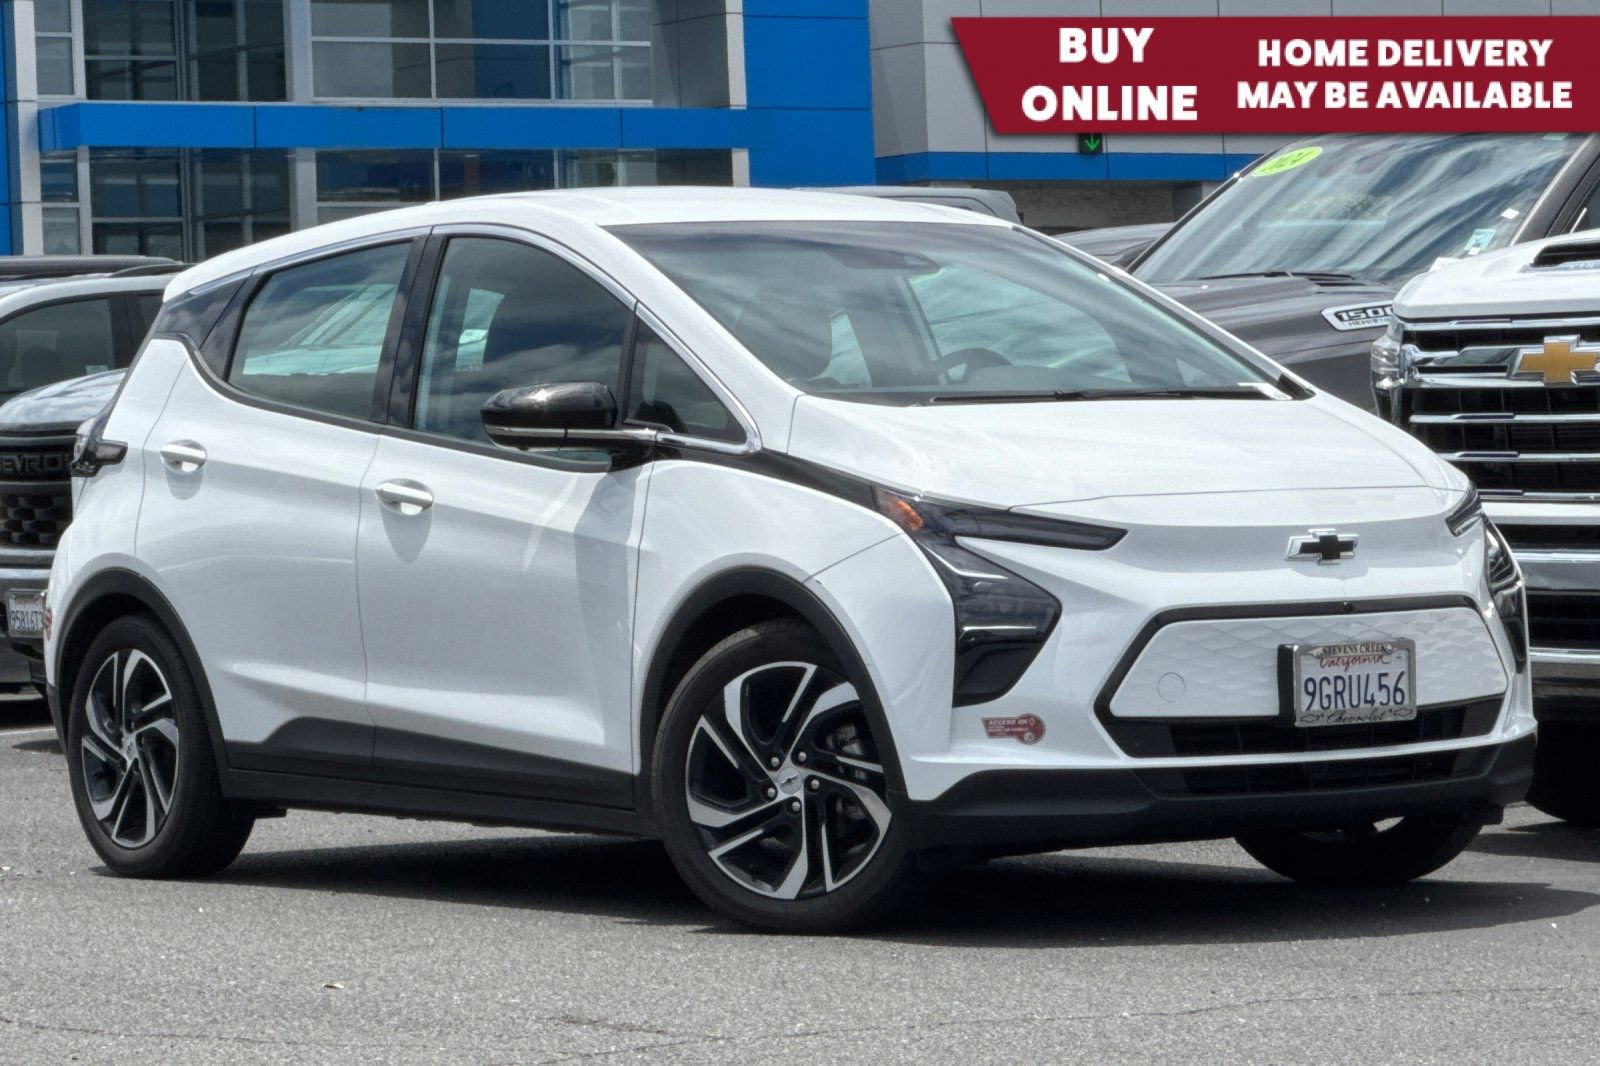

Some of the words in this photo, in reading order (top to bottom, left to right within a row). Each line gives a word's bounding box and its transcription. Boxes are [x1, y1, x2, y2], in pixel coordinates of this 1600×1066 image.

[1321, 645, 1358, 655] STEVENS
[1319, 655, 1390, 671] California
[1303, 671, 1405, 711] 9GRU456
